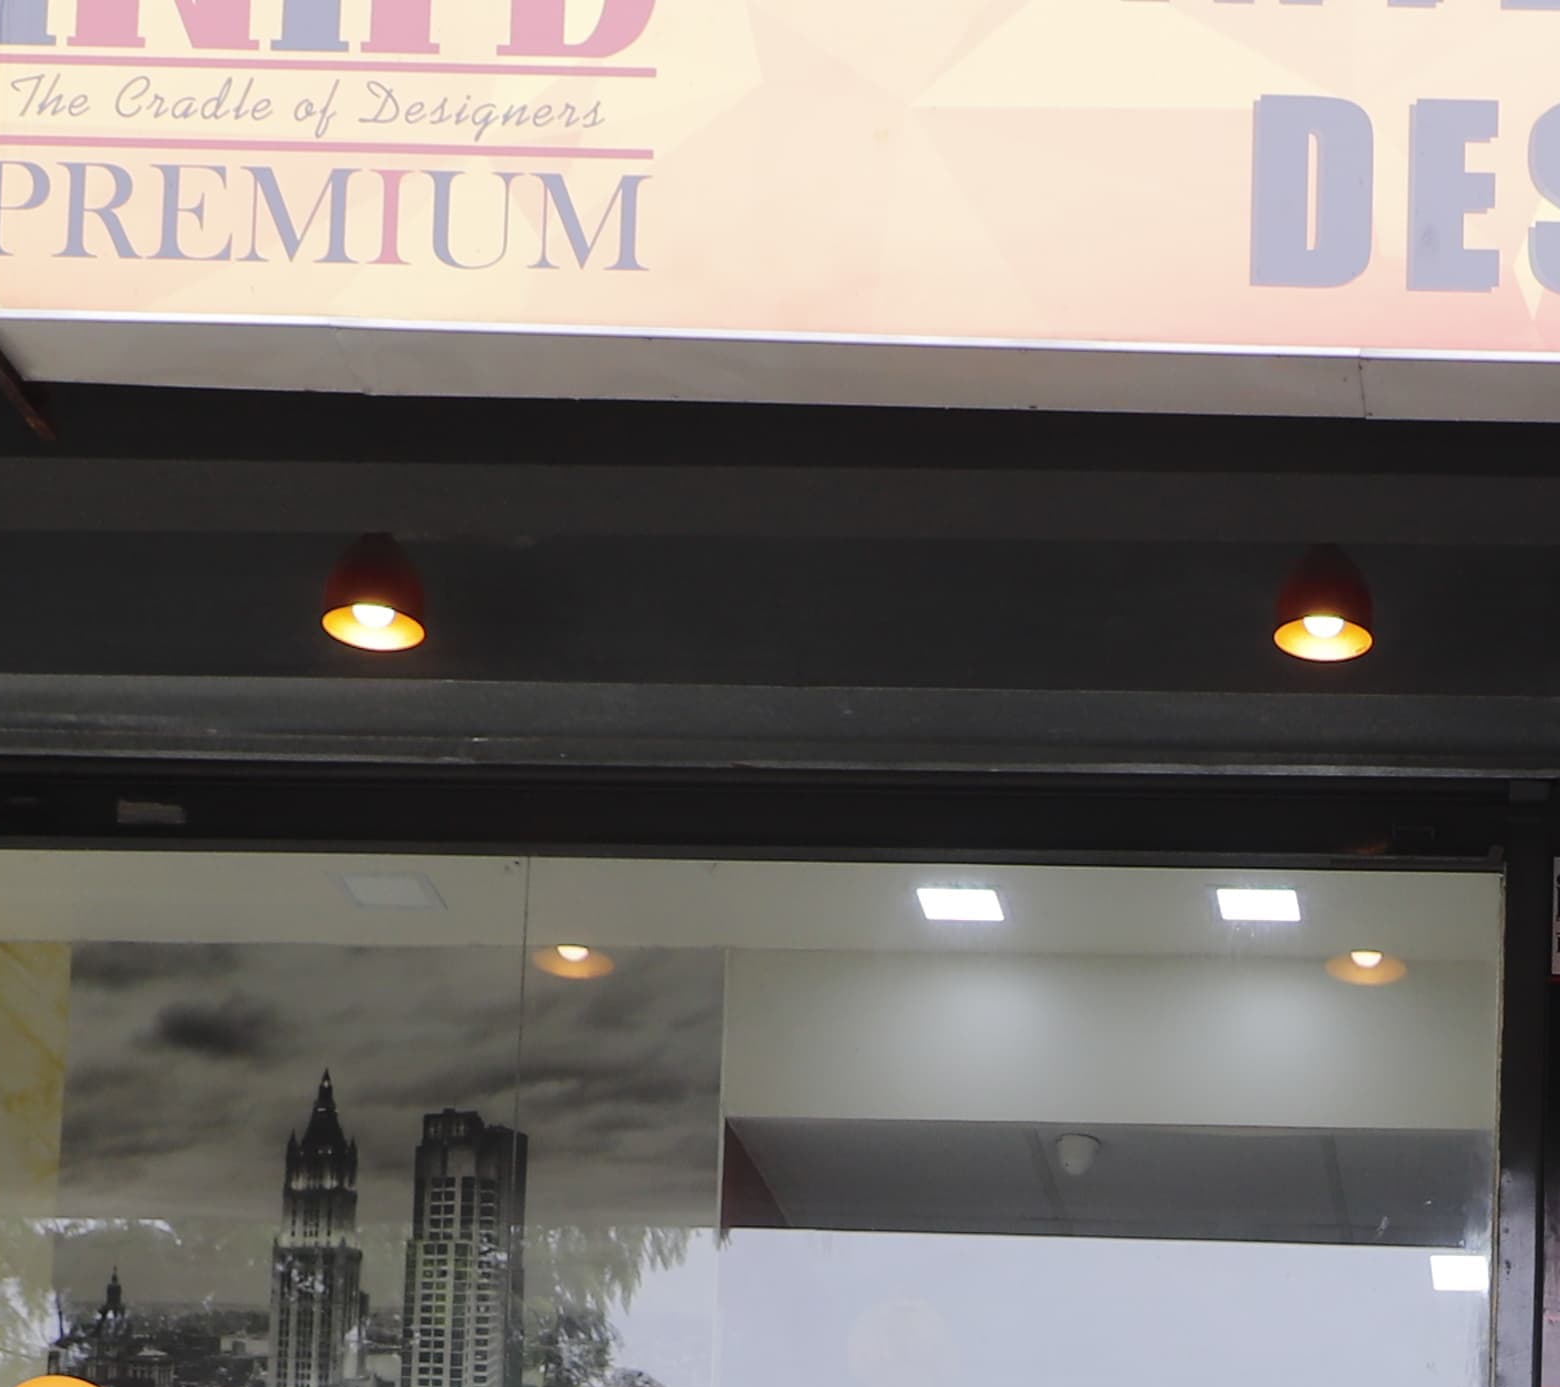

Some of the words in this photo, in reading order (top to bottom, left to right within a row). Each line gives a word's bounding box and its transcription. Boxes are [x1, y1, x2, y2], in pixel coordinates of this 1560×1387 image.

[11, 73, 90, 118] The
[113, 75, 274, 123] Cradle
[292, 78, 341, 139] of
[357, 80, 607, 142] Designers
